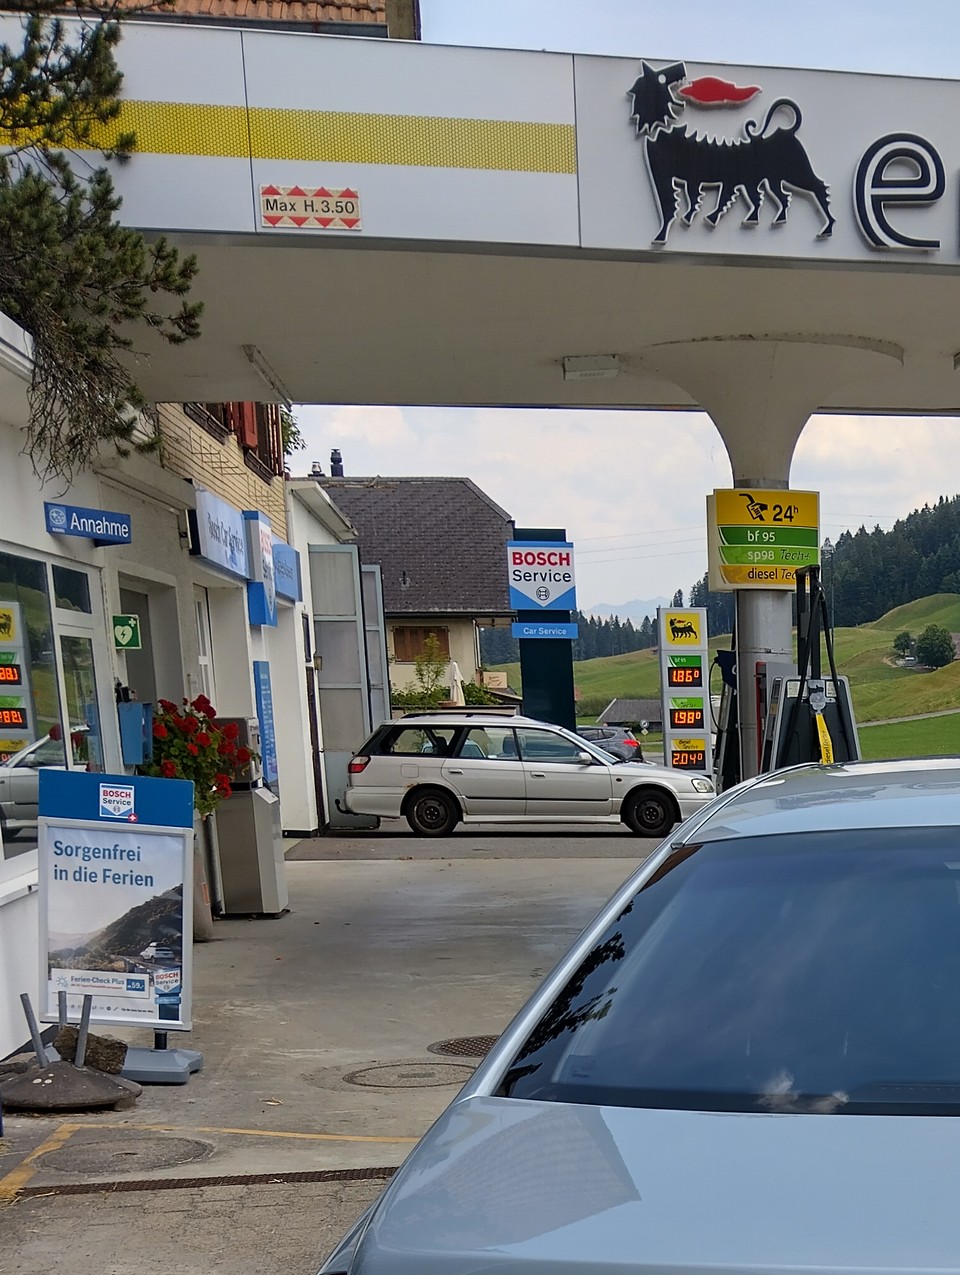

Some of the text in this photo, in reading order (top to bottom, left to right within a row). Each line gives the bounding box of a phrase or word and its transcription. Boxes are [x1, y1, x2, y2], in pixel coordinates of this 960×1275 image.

[265, 199, 296, 212] Max
[70, 512, 129, 538] Annahme
[747, 530, 776, 543] bf 95
[512, 551, 570, 566] BOSCH
[747, 548, 811, 563] sp98 Tech+
[512, 568, 572, 583] Service
[747, 567, 778, 580] diesel
[523, 626, 567, 636] Car Service
[102, 789, 132, 799] BOSCH
[102, 797, 132, 806] Service
[53, 840, 141, 862] Sorgenfrei
[53, 864, 154, 887] in die Ferien
[155, 972, 179, 980] BOSCH
